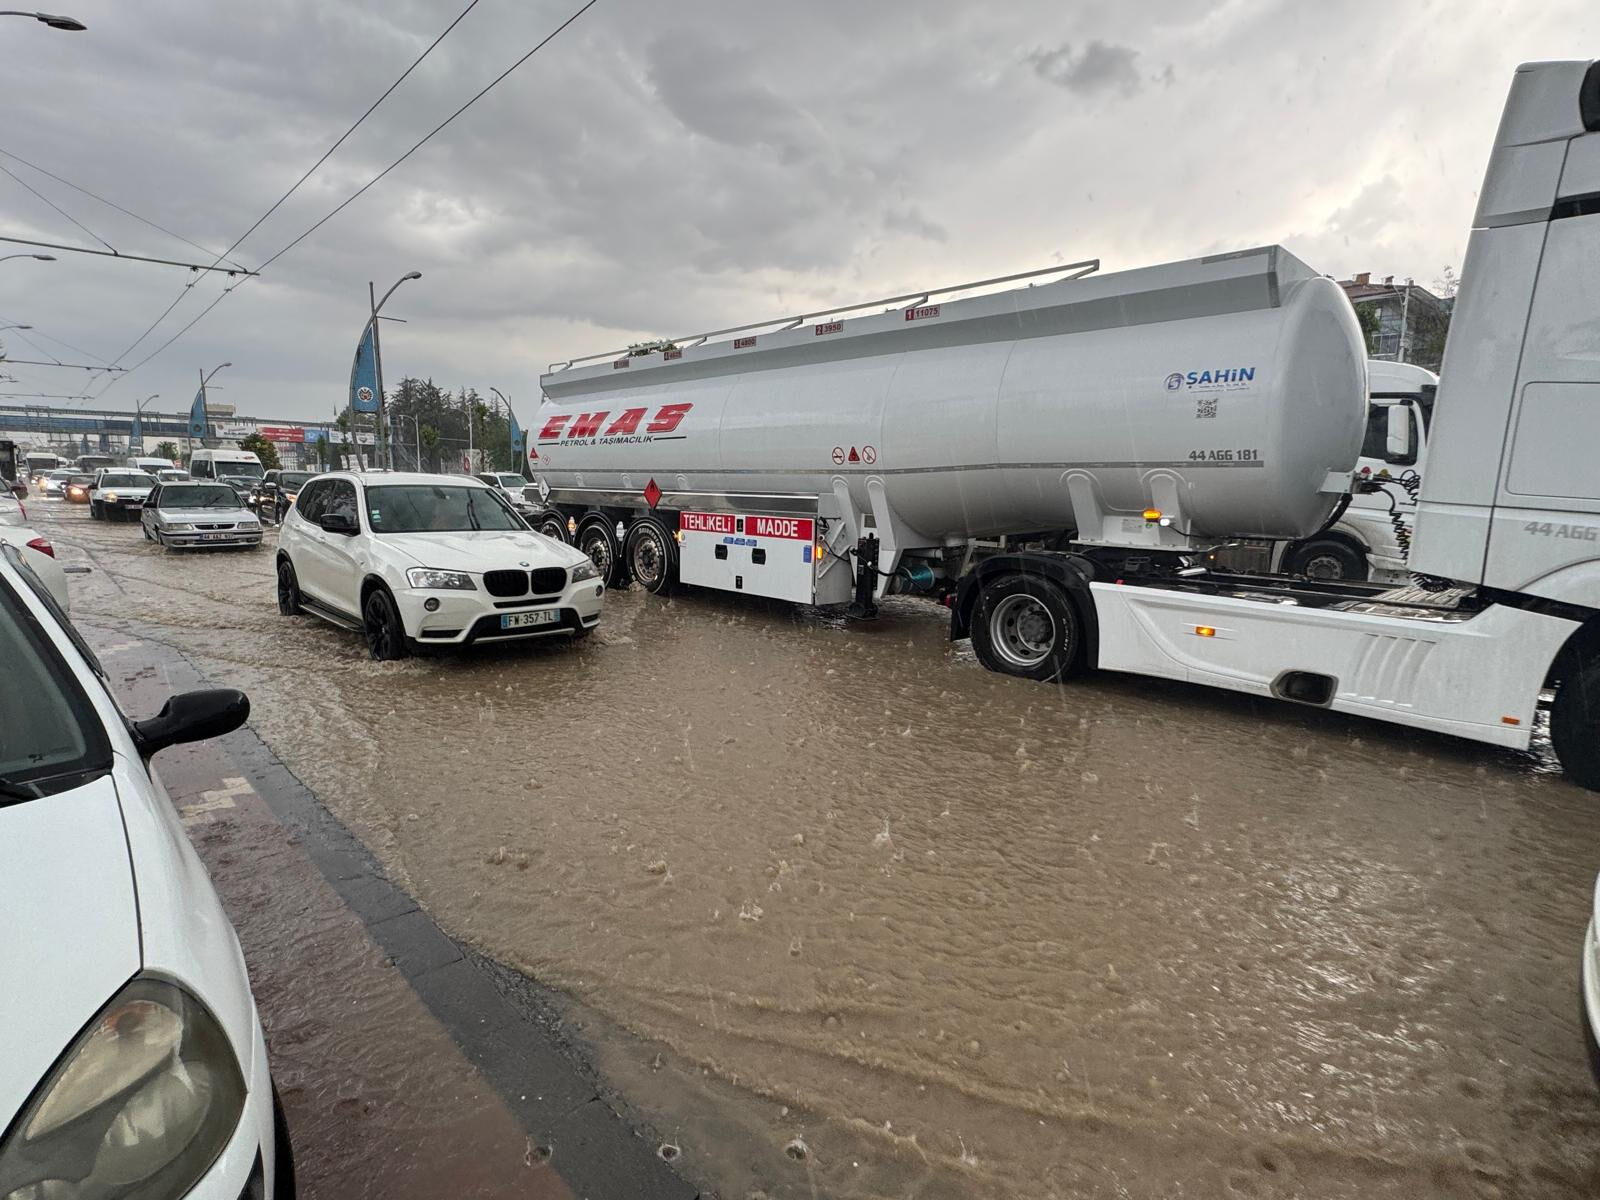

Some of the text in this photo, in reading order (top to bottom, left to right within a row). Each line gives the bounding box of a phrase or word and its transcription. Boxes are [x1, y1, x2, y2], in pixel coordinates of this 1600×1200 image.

[538, 402, 694, 440] EMAS
[560, 439, 589, 447] PETROL
[1189, 450, 1206, 461] 44
[1236, 449, 1258, 460] 181
[757, 518, 798, 537] MADDE
[1524, 521, 1553, 536] 44
